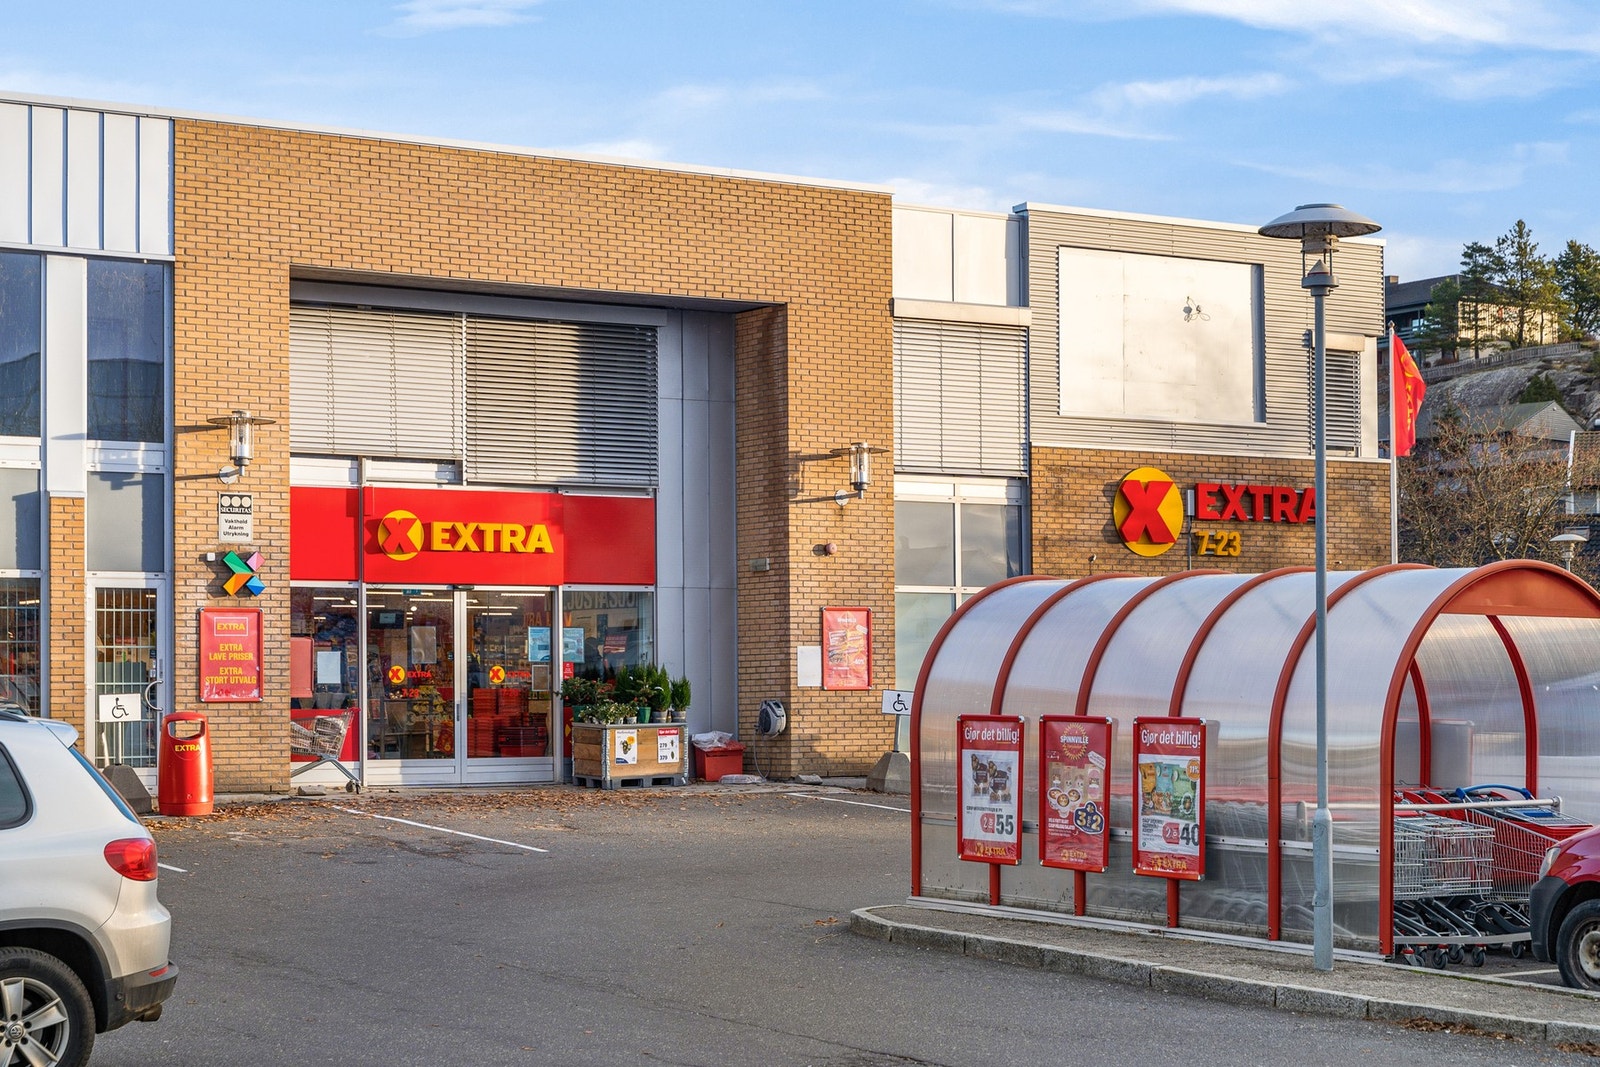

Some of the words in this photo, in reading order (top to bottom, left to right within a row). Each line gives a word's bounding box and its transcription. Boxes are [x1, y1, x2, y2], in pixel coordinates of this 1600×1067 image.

[1119, 480, 1176, 543] X
[1194, 483, 1317, 523] EXTRA
[382, 517, 420, 554] X
[431, 521, 554, 553] EXTRA
[1196, 530, 1241, 557] 7-23
[209, 652, 226, 660] LAVE
[220, 643, 243, 651] EXTRA
[205, 676, 227, 684] STORT
[230, 676, 257, 684] UTVALG
[220, 667, 242, 675] EXTRA
[964, 727, 979, 743] Gjør
[981, 728, 995, 741] det
[996, 729, 1020, 745] billig!
[1060, 735, 1089, 744] SPINNVILLE
[1141, 729, 1158, 746] Gjør
[1159, 730, 1174, 745] det
[1175, 731, 1201, 748] billig!
[996, 814, 1014, 836] 55
[1076, 811, 1086, 826] 3
[1091, 814, 1101, 831] 2
[1180, 823, 1200, 847] 40
